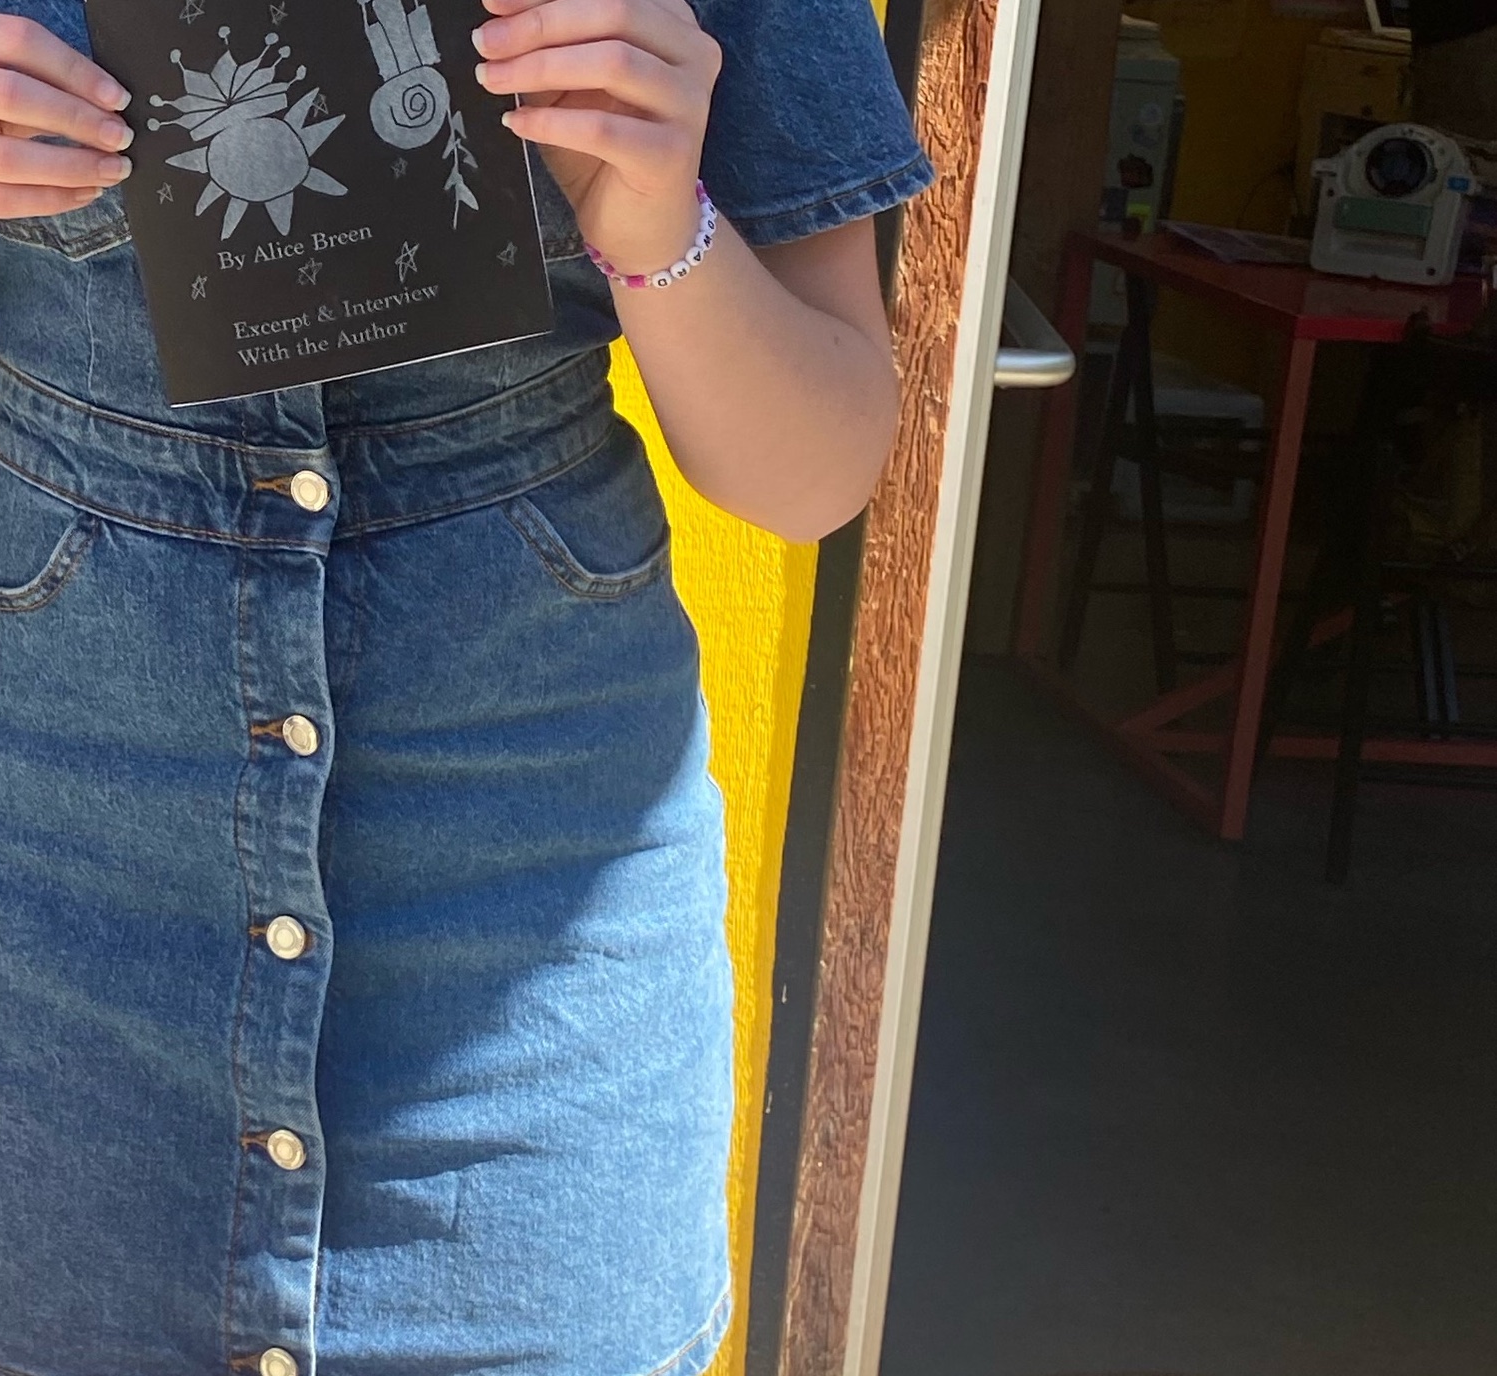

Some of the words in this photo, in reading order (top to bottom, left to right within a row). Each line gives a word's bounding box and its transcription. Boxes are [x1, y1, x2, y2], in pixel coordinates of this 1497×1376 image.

[217, 251, 246, 270] By
[254, 241, 305, 263] Alice
[311, 226, 373, 252] Breen
[233, 313, 311, 340] Excerpt
[317, 305, 335, 322] &
[342, 285, 439, 318] Interview
[237, 341, 290, 366] With
[296, 337, 329, 356] the
[337, 321, 408, 348] Author
